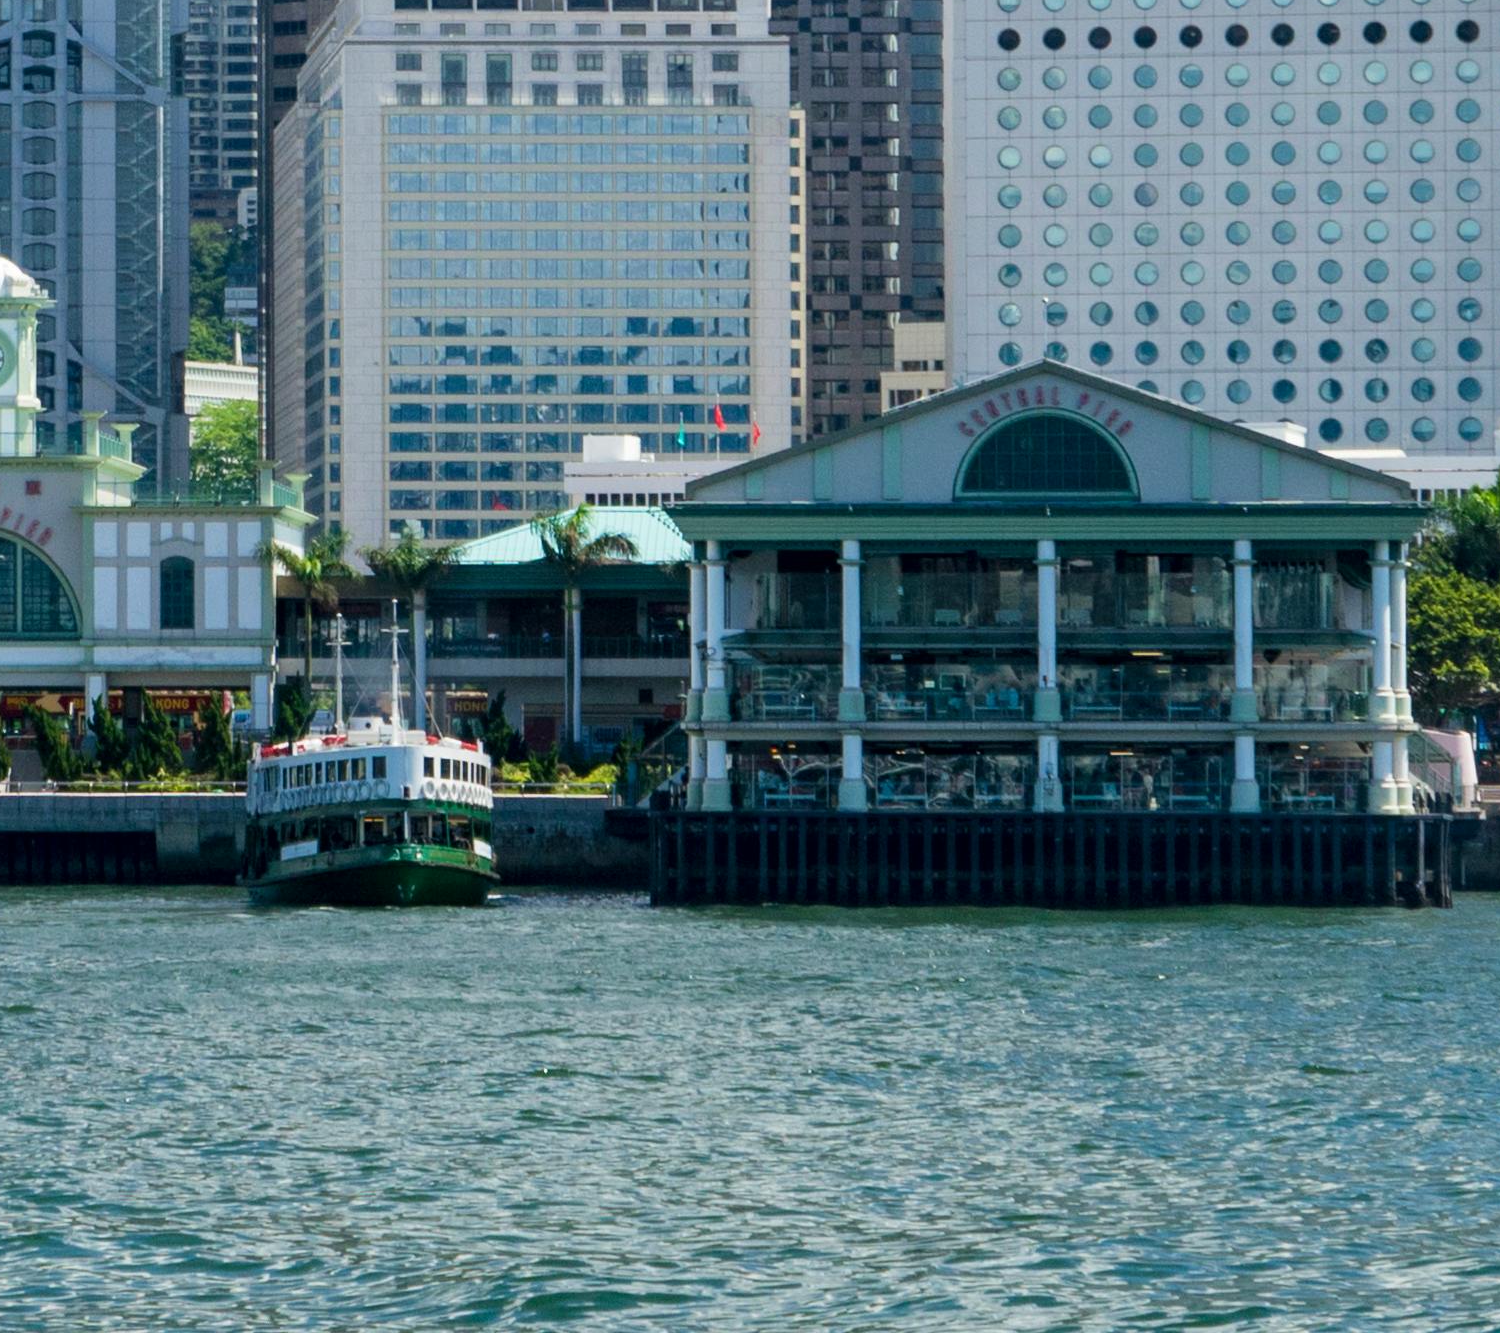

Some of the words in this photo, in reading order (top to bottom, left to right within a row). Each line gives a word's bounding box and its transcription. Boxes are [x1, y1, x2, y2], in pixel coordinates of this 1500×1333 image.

[957, 385, 1061, 437] CENTRAL
[1077, 391, 1133, 437] PIER
[155, 698, 190, 710] KONG
